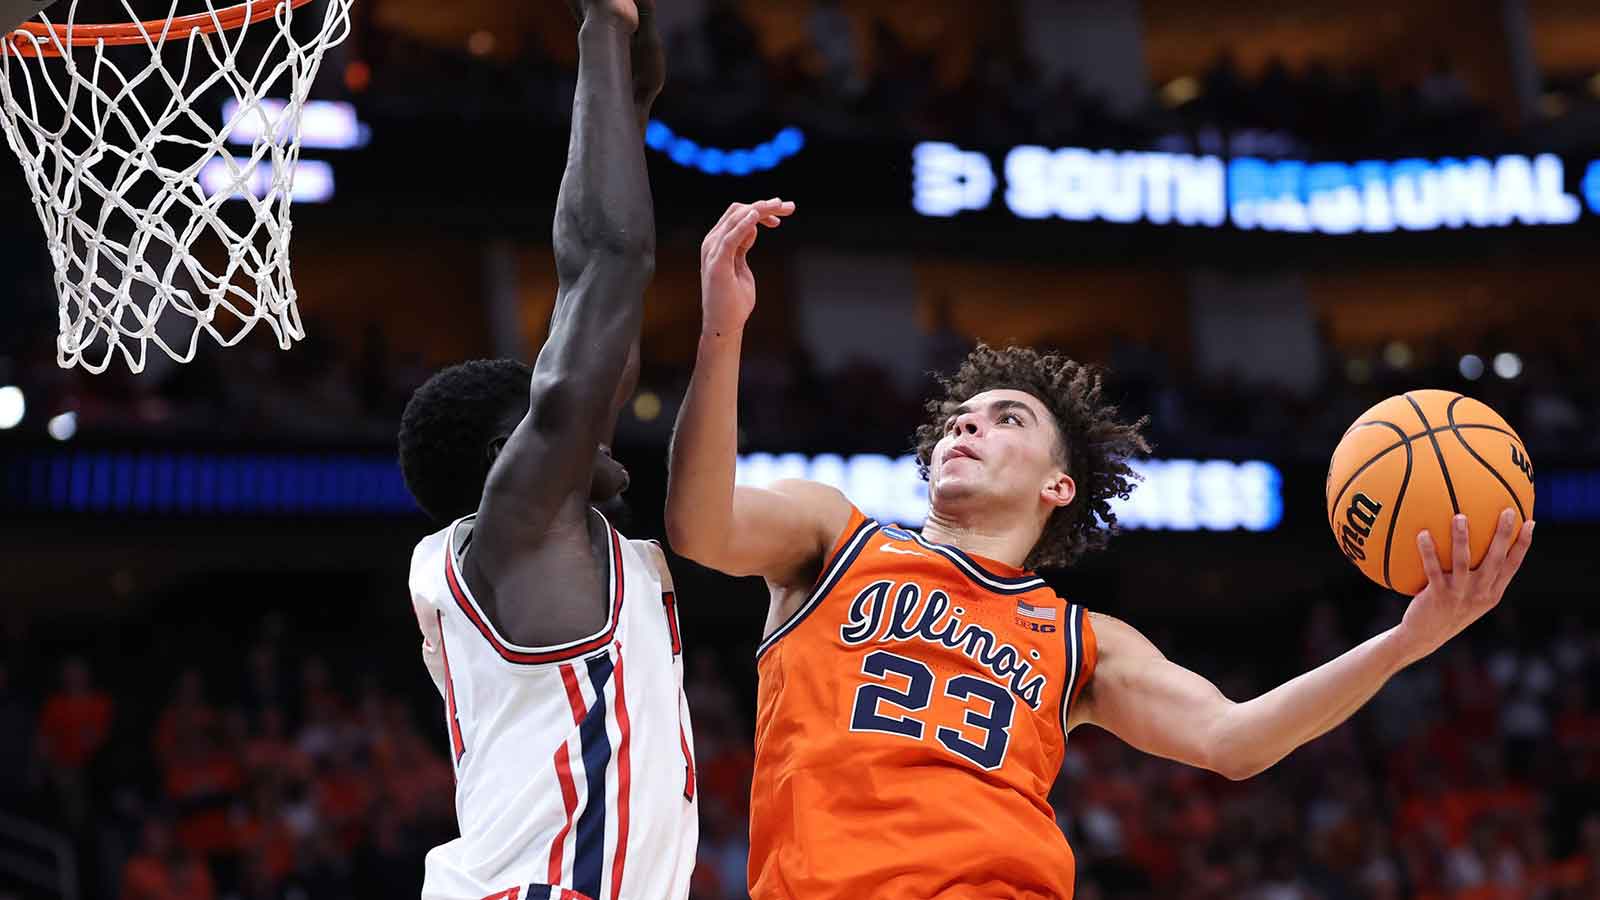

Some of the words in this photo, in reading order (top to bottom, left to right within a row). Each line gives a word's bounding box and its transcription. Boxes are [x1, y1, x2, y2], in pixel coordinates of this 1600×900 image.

[1005, 145, 1226, 226] SOUTH
[1229, 153, 1581, 233] REGIONAL
[840, 579, 1046, 712] Illinois
[849, 650, 1016, 772] 23
